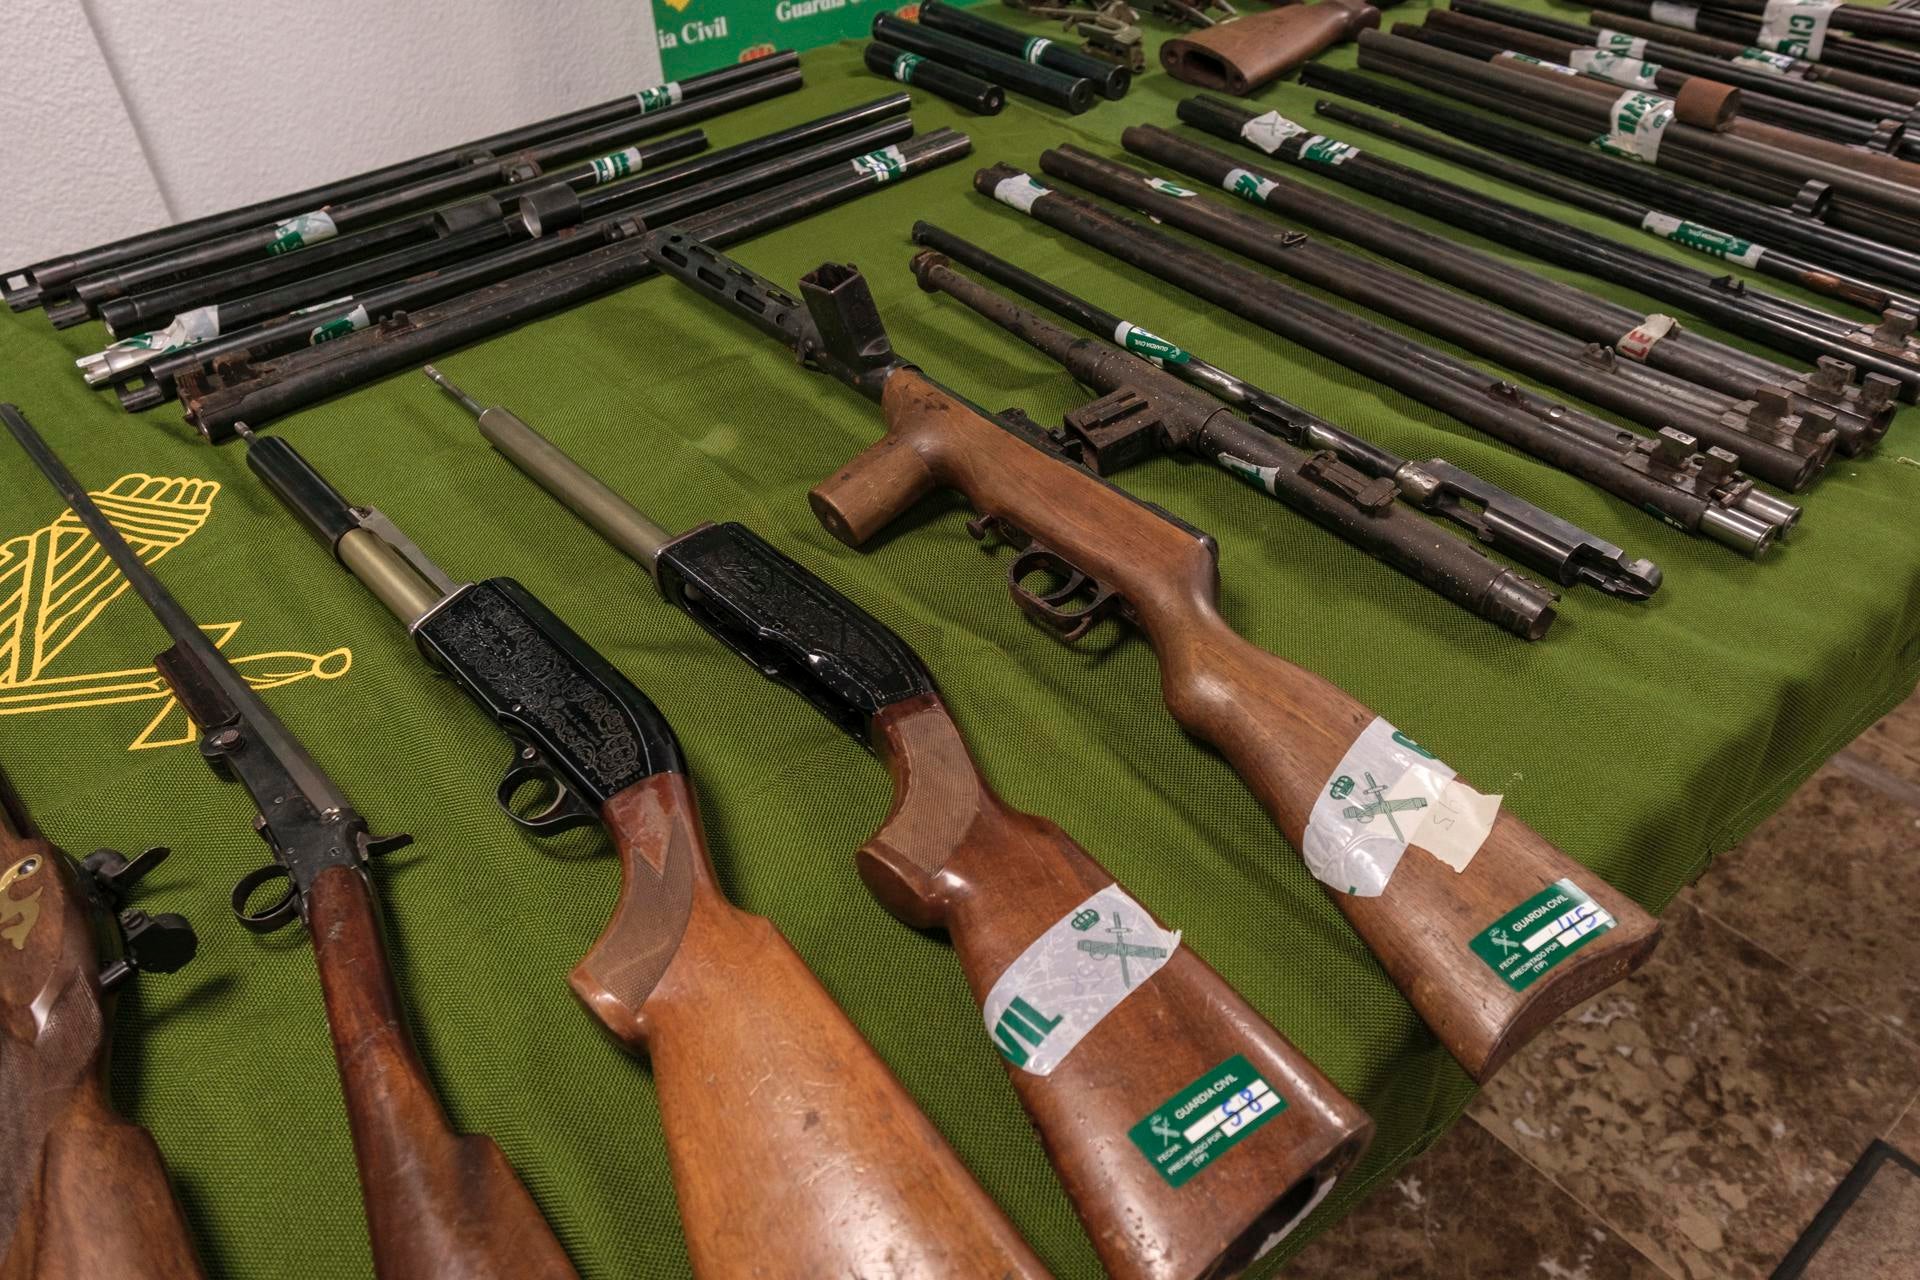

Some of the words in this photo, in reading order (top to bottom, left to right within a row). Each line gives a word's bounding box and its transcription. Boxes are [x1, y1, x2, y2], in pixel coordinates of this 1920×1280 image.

[681, 16, 728, 45] Civil
[1512, 906, 1550, 932] GUARDIA
[1547, 894, 1569, 909] CIVIL
[1556, 906, 1598, 936] 45
[1509, 950, 1547, 980] PRECINTADO
[1545, 942, 1560, 954] POR
[1175, 1087, 1216, 1119] GUARDIA
[1213, 1074, 1239, 1092] CIVIL
[1222, 1088, 1263, 1127] 58
